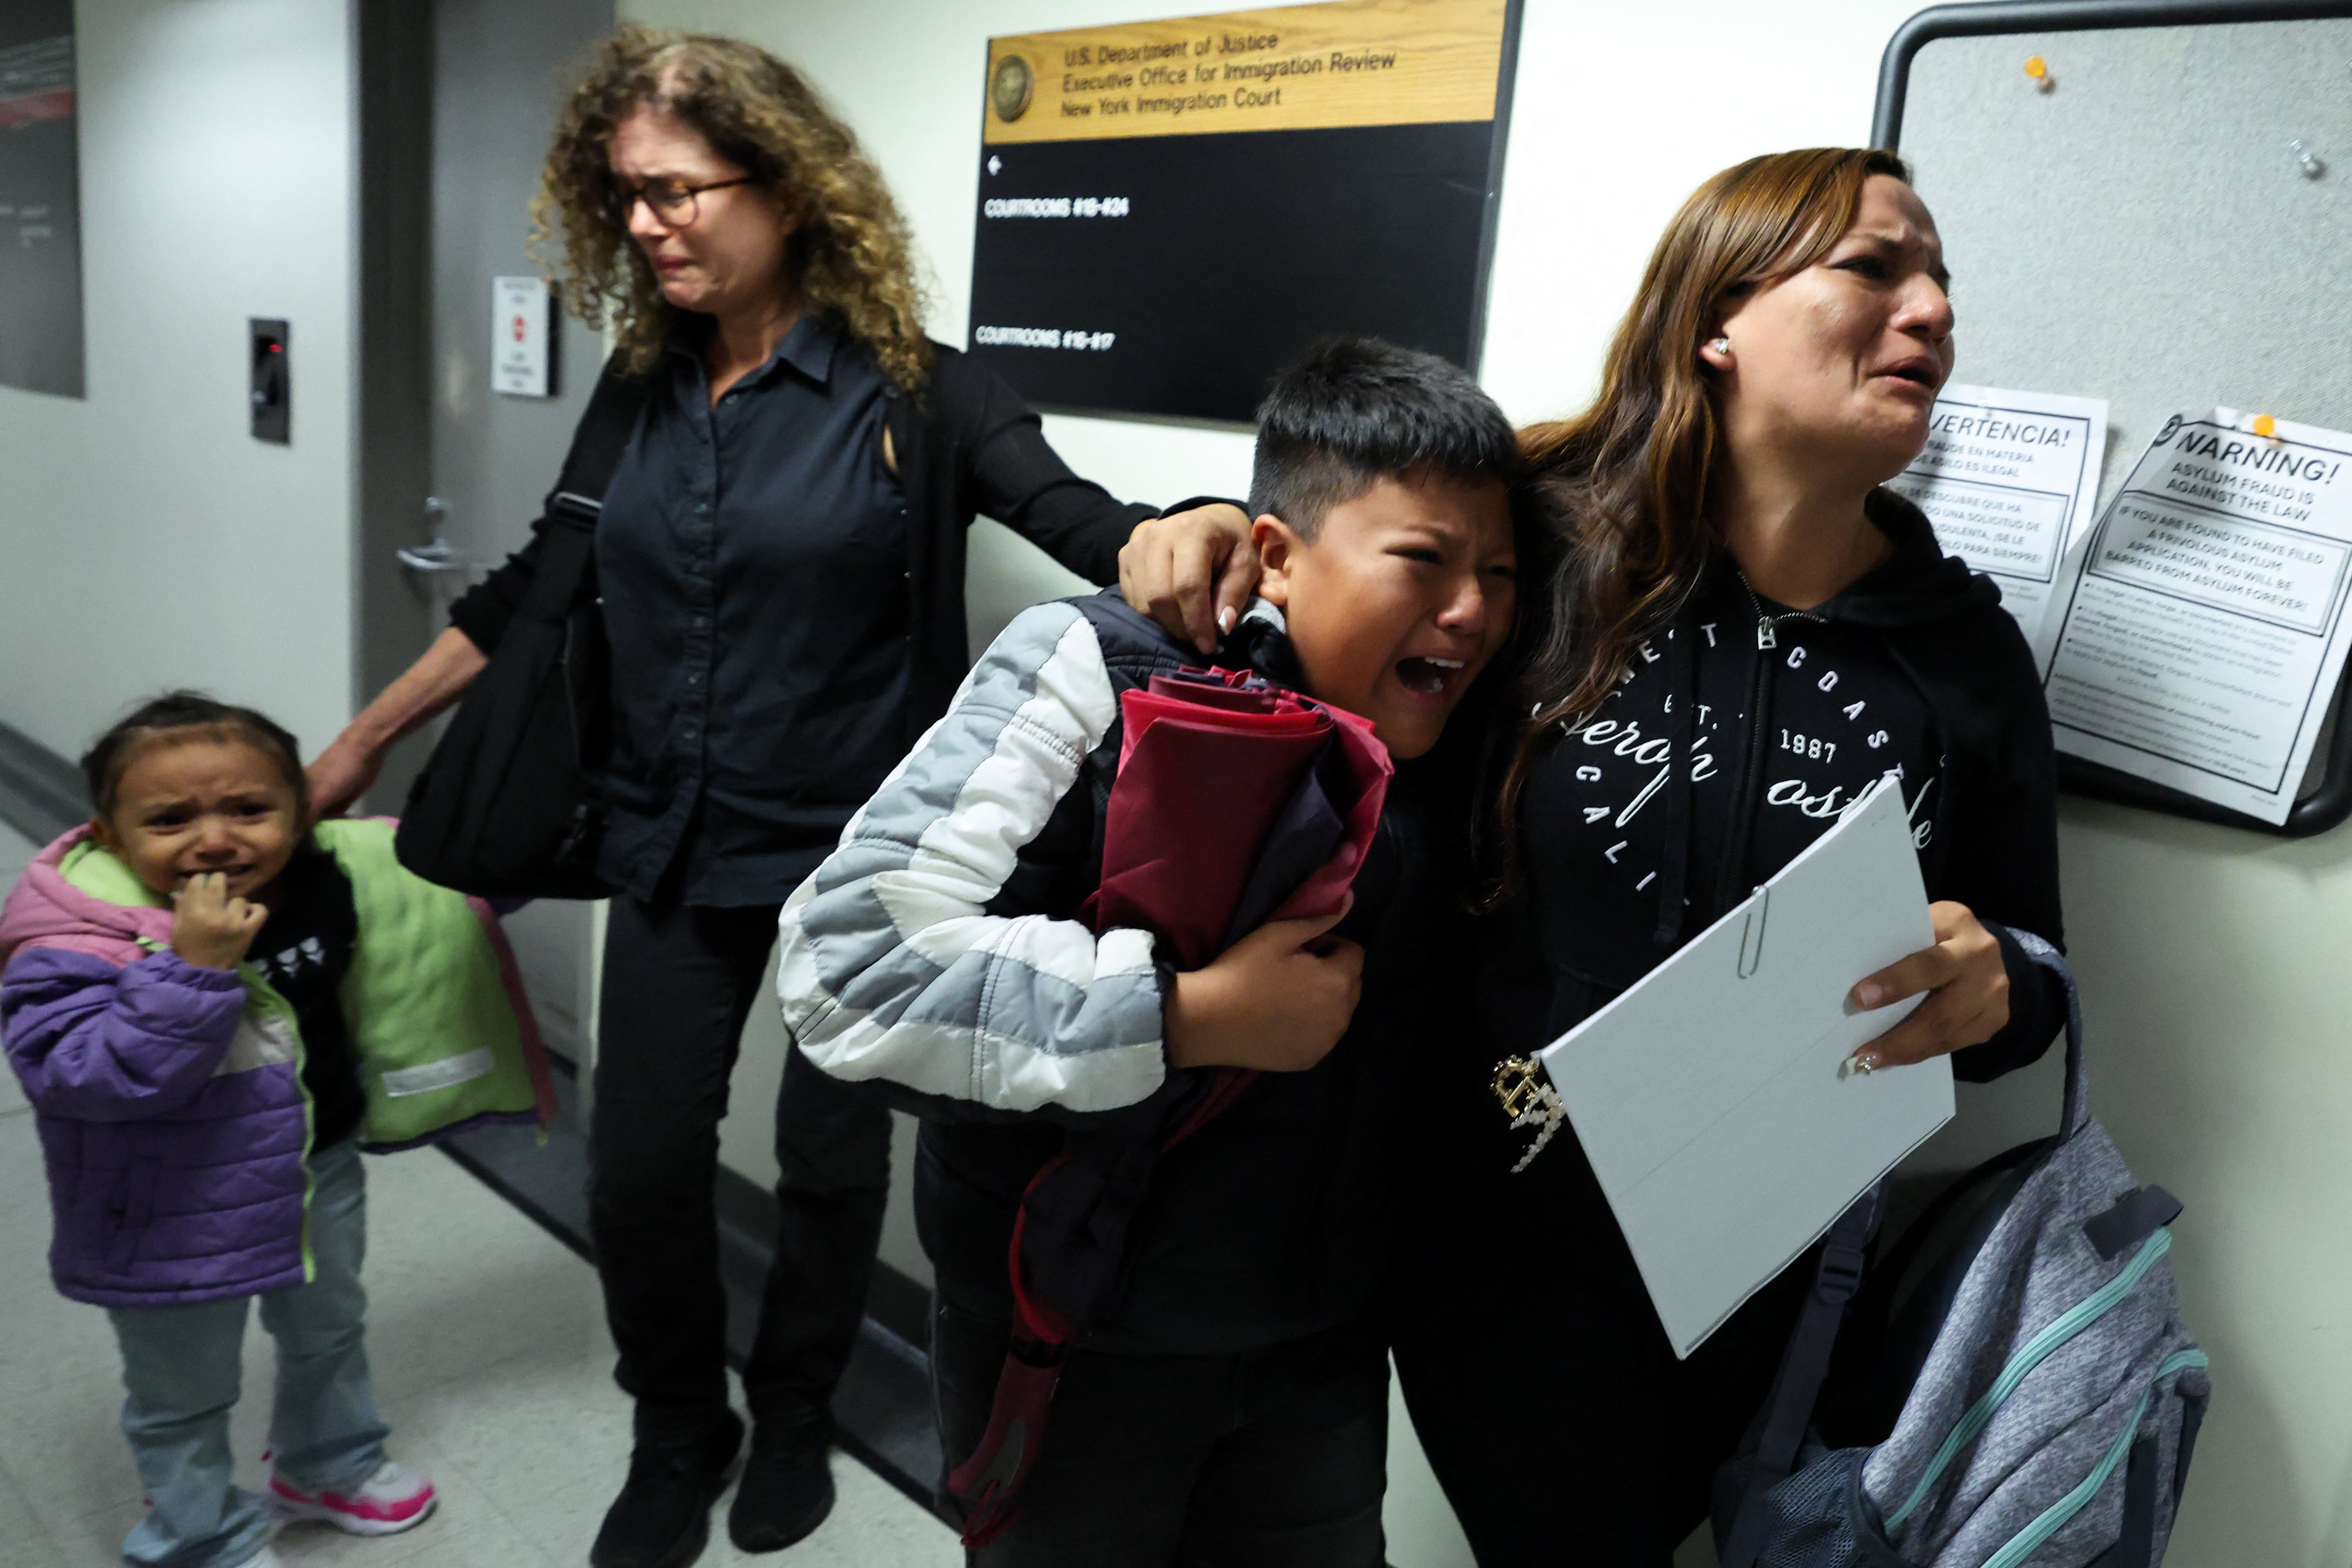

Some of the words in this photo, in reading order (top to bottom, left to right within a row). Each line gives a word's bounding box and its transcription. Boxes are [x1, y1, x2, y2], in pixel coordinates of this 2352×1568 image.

[1098, 41, 1188, 64] Department
[1194, 35, 1212, 56] of
[1218, 33, 1278, 54] Justice
[1063, 72, 1134, 93] Executive
[1139, 66, 1187, 87] Office
[1195, 63, 1217, 82] for
[1224, 56, 1322, 82] Immigration
[1330, 49, 1396, 72] Review
[1061, 100, 1091, 117] New
[1099, 97, 1129, 115] York
[1137, 93, 1226, 116] Immigration
[1234, 87, 1281, 108] Court
[984, 198, 1072, 218] COURTROOMS
[975, 325, 1062, 349] COURTROOMS
[1927, 439, 1965, 454] RAUDE
[2175, 430, 2342, 485] WARNING!
[2166, 478, 2238, 504] AGAINST
[2239, 494, 2270, 514] THE
[2273, 503, 2312, 522] LAW
[2171, 462, 2237, 487] ASYLUM
[2239, 478, 2294, 501] FRAUD
[2298, 491, 2314, 505] IS
[2133, 509, 2159, 523] YOU
[2159, 516, 2184, 529] ARE
[2185, 522, 2231, 541] FOUND
[2234, 534, 2250, 546] TO
[2251, 540, 2287, 556] HAVE
[2288, 548, 2325, 564] FILED
[2147, 529, 2156, 538] A
[1780, 728, 1836, 764] 1887
